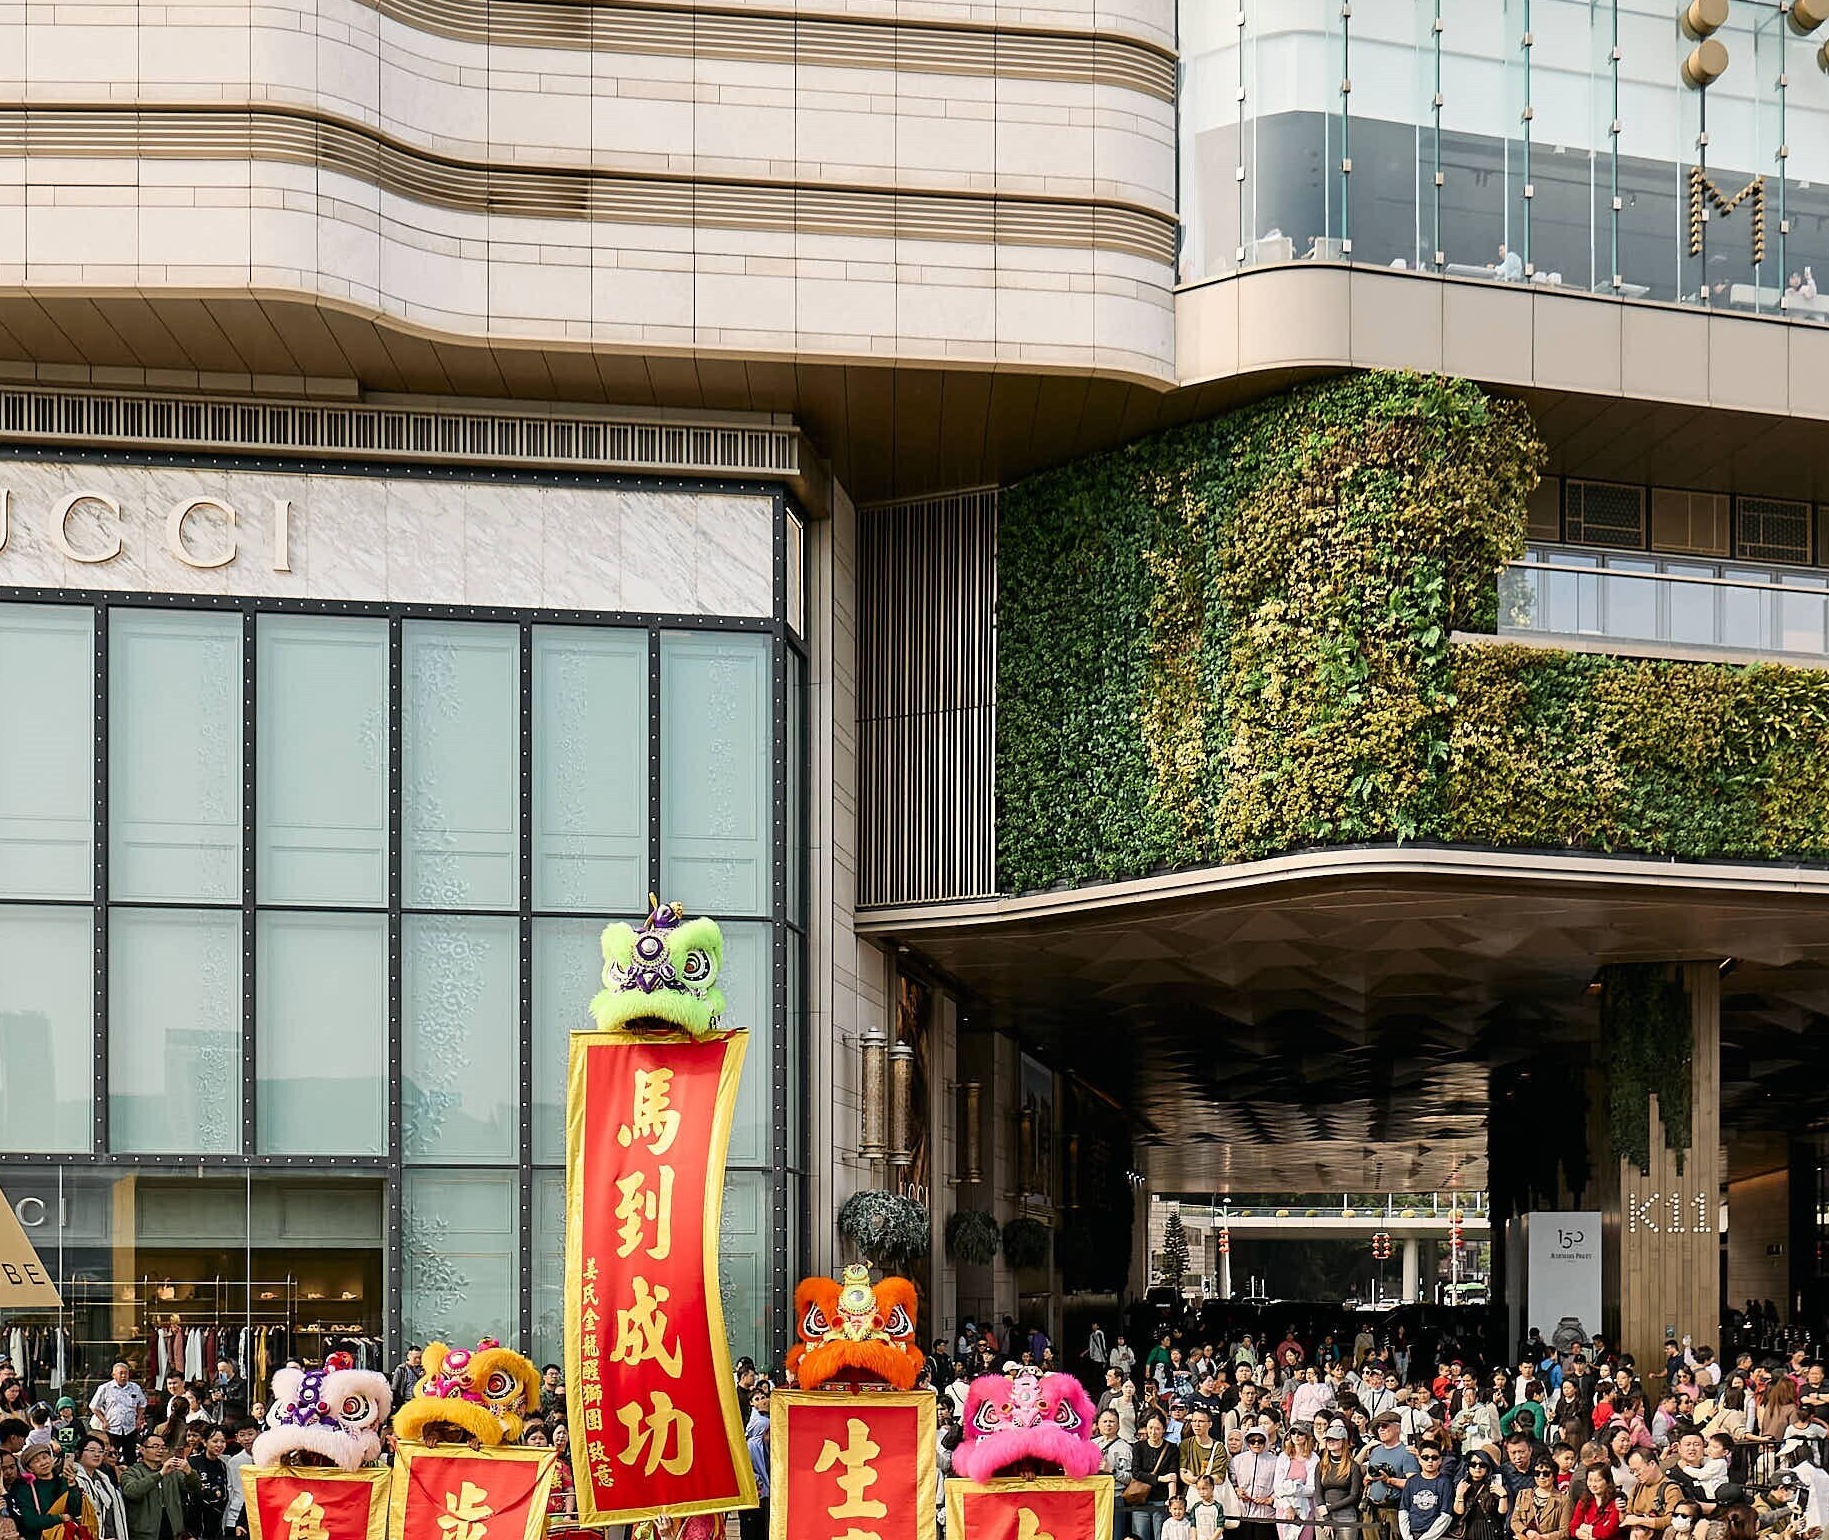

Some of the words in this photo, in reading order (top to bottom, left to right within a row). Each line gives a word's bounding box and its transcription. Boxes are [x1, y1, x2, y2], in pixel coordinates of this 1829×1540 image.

[610, 1068, 694, 1477] 馬到成功
[1630, 1193, 1711, 1233] K11
